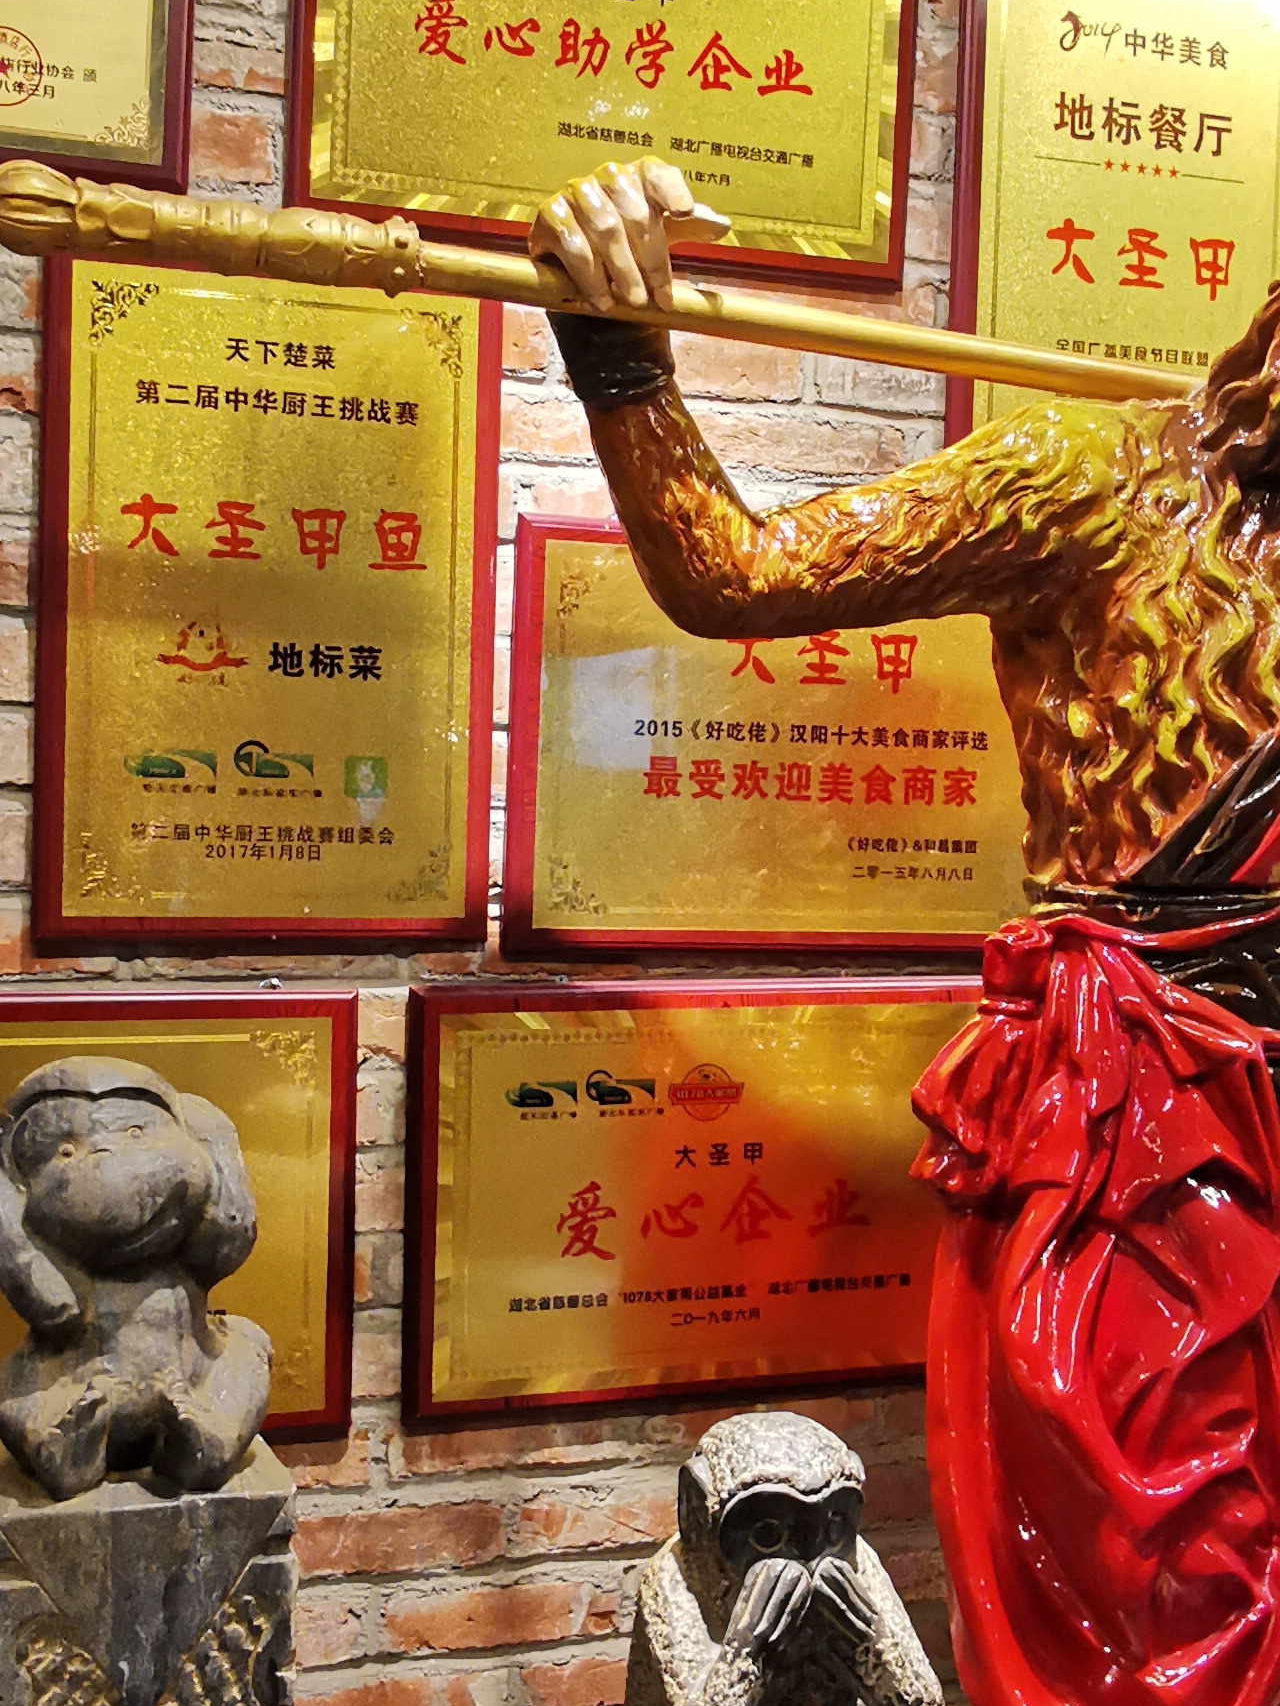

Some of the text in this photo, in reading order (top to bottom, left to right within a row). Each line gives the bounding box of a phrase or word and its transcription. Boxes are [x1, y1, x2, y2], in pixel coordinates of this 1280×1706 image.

[1054, 91, 1233, 158] 地标餐厅
[1046, 217, 1236, 302] 大圣甲
[225, 337, 336, 371] 天下楚菜
[136, 379, 420, 427] 第二届中华厨王挑战赛
[120, 492, 428, 571] 大圣甲鱼
[268, 642, 383, 681] 地标菜
[643, 754, 978, 808] 最受欢迎美食商家
[131, 822, 395, 845] 第二届中华厨王挑战赛组委会
[205, 842, 321, 861] 2017年1月8日
[675, 1142, 764, 1169] 大圣甲
[556, 1175, 871, 1262] 爱心企业
